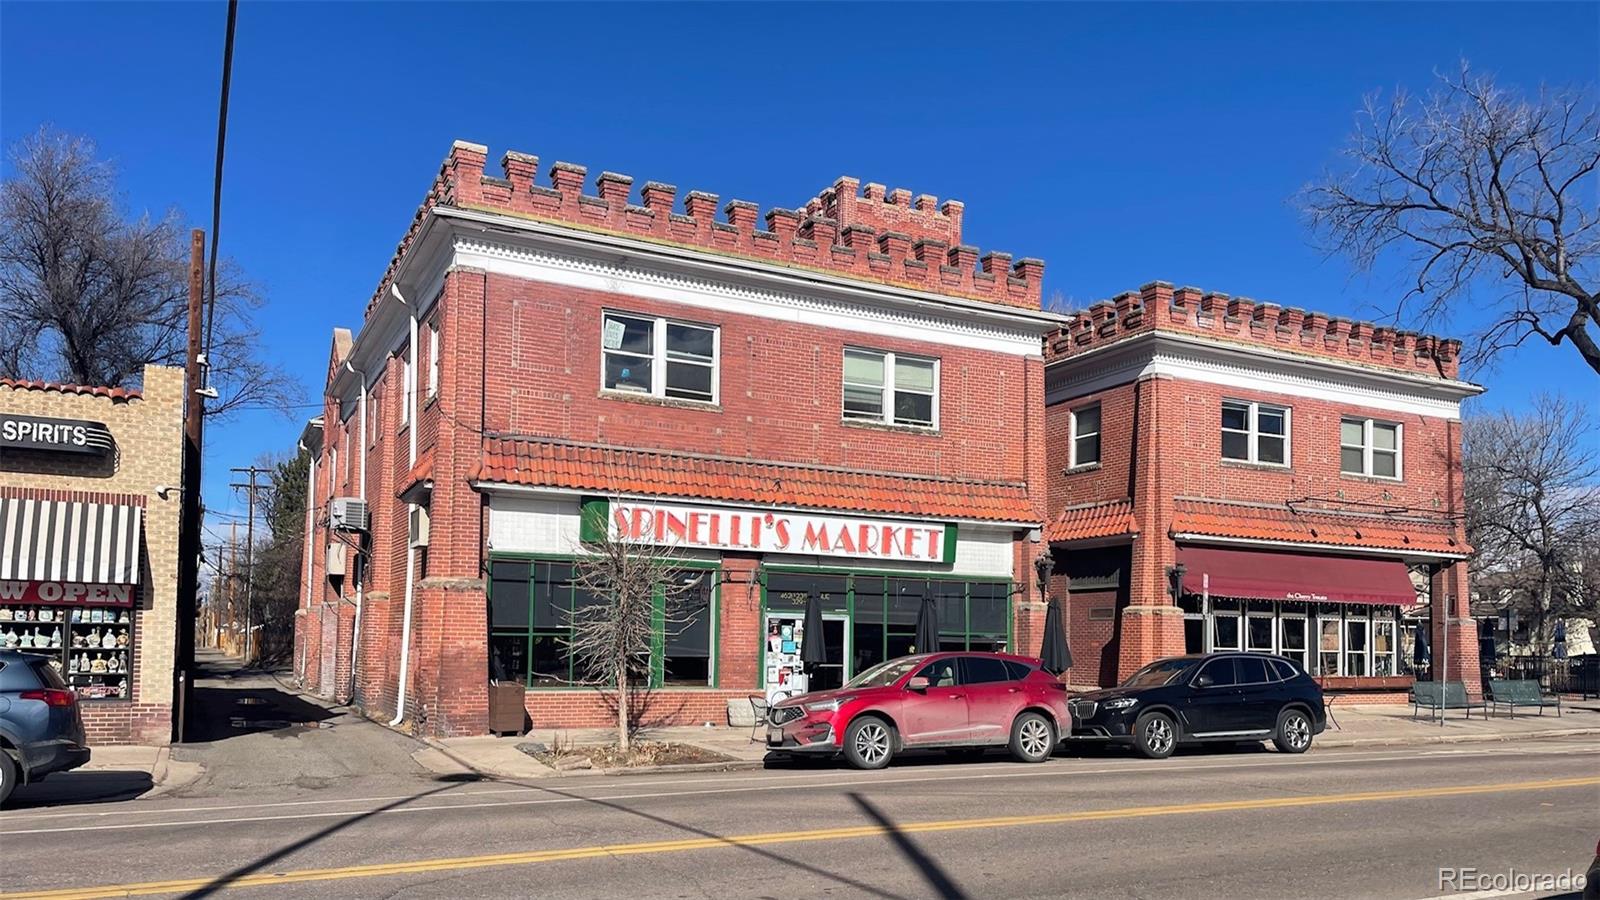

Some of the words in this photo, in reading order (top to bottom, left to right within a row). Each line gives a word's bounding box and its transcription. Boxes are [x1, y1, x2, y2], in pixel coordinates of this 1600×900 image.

[2, 420, 87, 446] SPIRITS
[611, 507, 791, 551] SPINELLI'S
[801, 520, 944, 560] MARKET
[37, 581, 132, 603] OPEN
